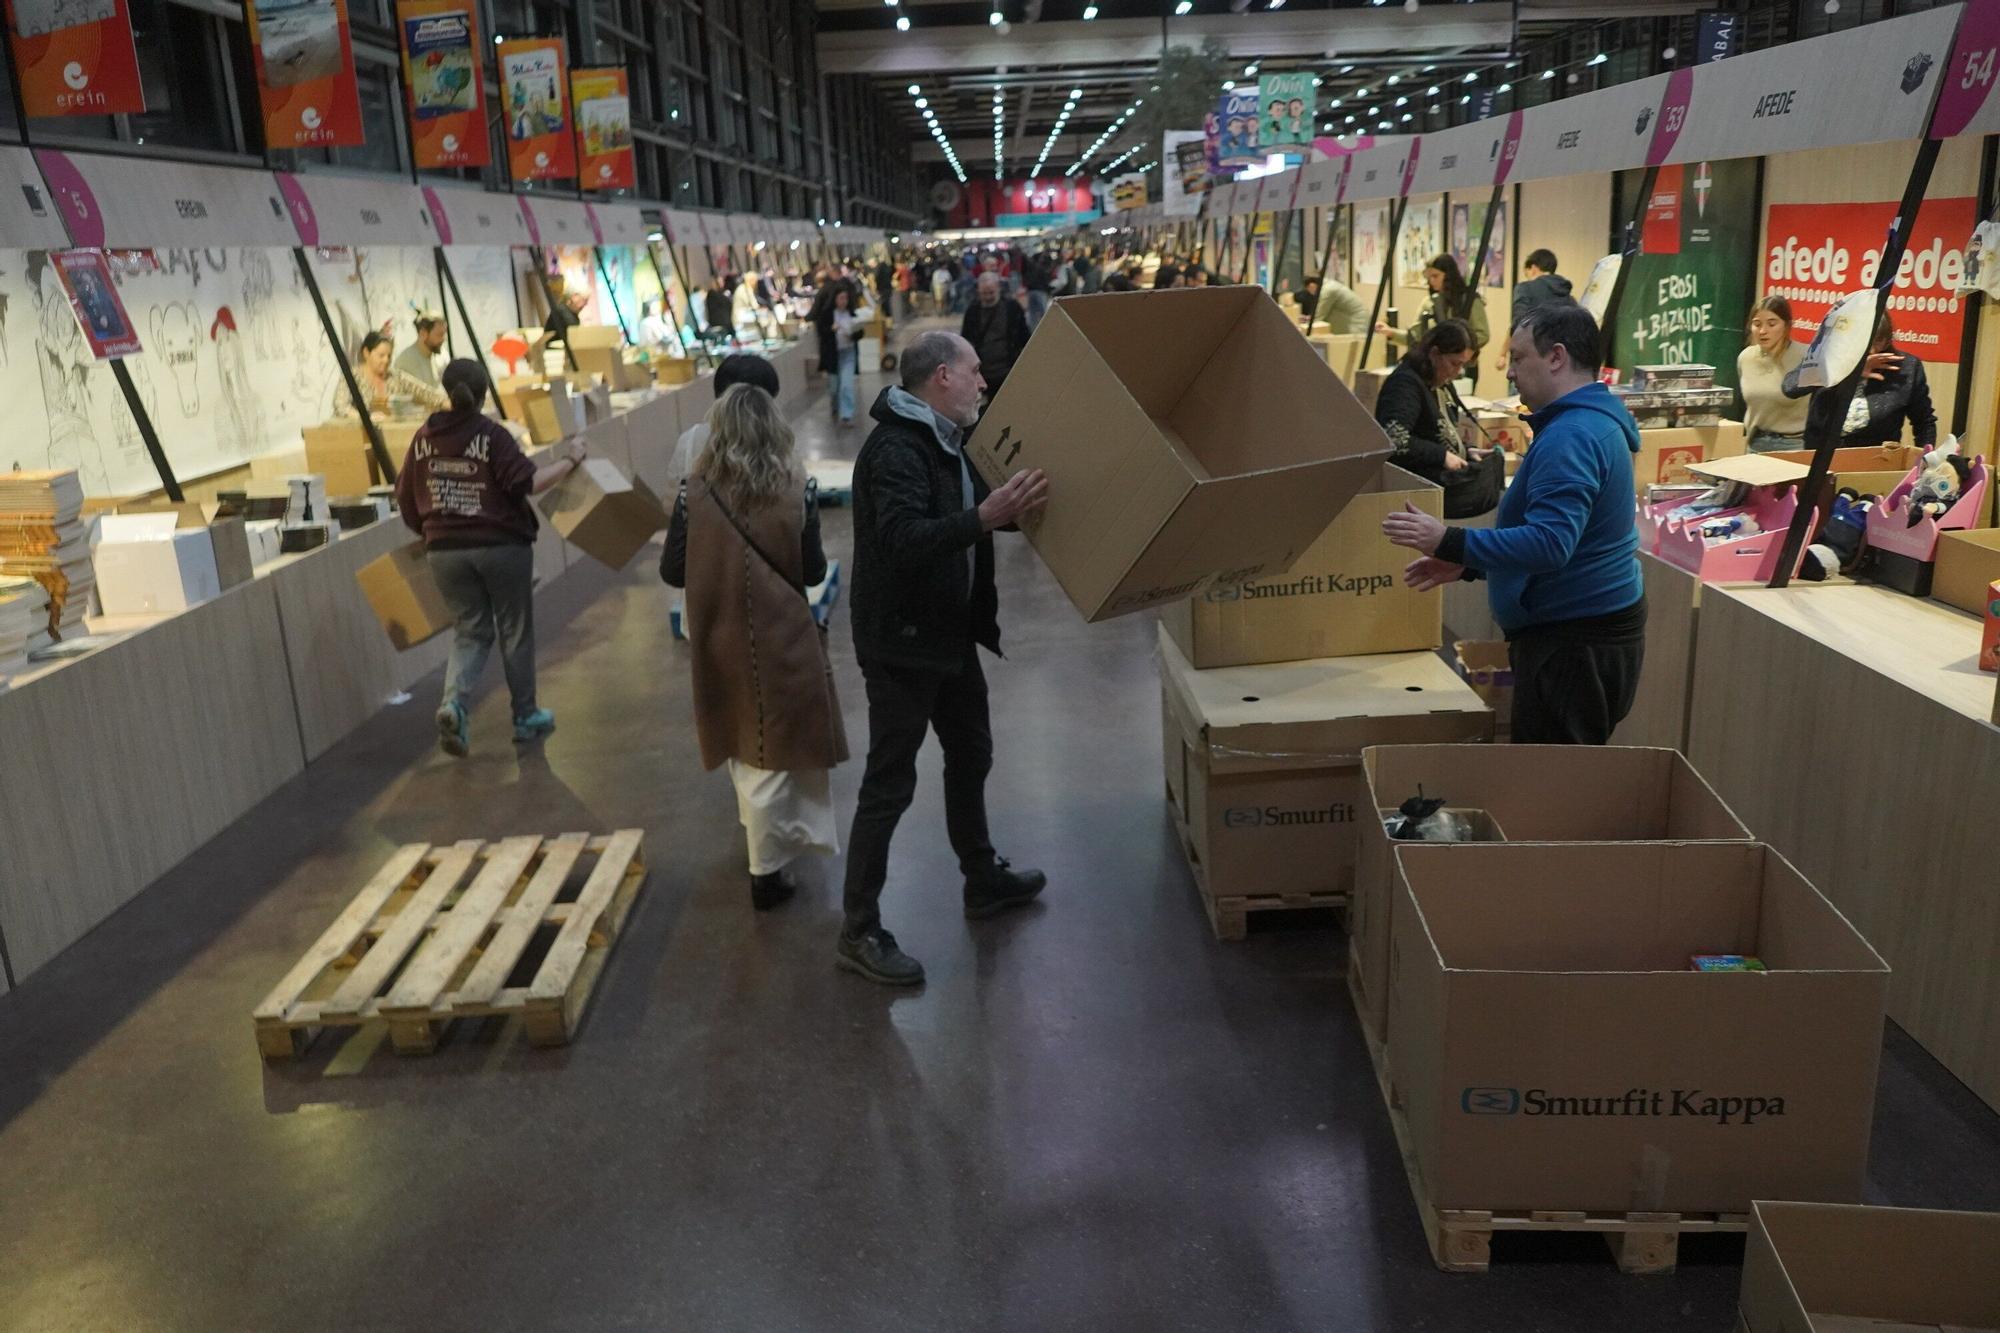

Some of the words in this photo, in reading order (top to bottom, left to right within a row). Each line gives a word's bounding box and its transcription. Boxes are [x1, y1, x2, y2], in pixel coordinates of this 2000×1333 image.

[1961, 48, 1996, 89] 54
[56, 90, 106, 107] erein
[1753, 90, 1796, 119] AFEDE
[1666, 105, 1684, 131] 53
[295, 129, 335, 142] erein
[71, 191, 88, 220] 5
[1769, 236, 1850, 285] afede
[1861, 237, 1965, 291] aede
[1658, 272, 1697, 306] EROSI
[1648, 304, 1713, 340] BAZKIDE
[1658, 338, 1693, 365] TOKI
[1242, 575, 1325, 601] Smurfit
[1328, 572, 1393, 597] Kappa
[1265, 802, 1355, 827] Smurfit
[1524, 1089, 1663, 1118] Smurfit
[1670, 1090, 1785, 1125] Kappa
